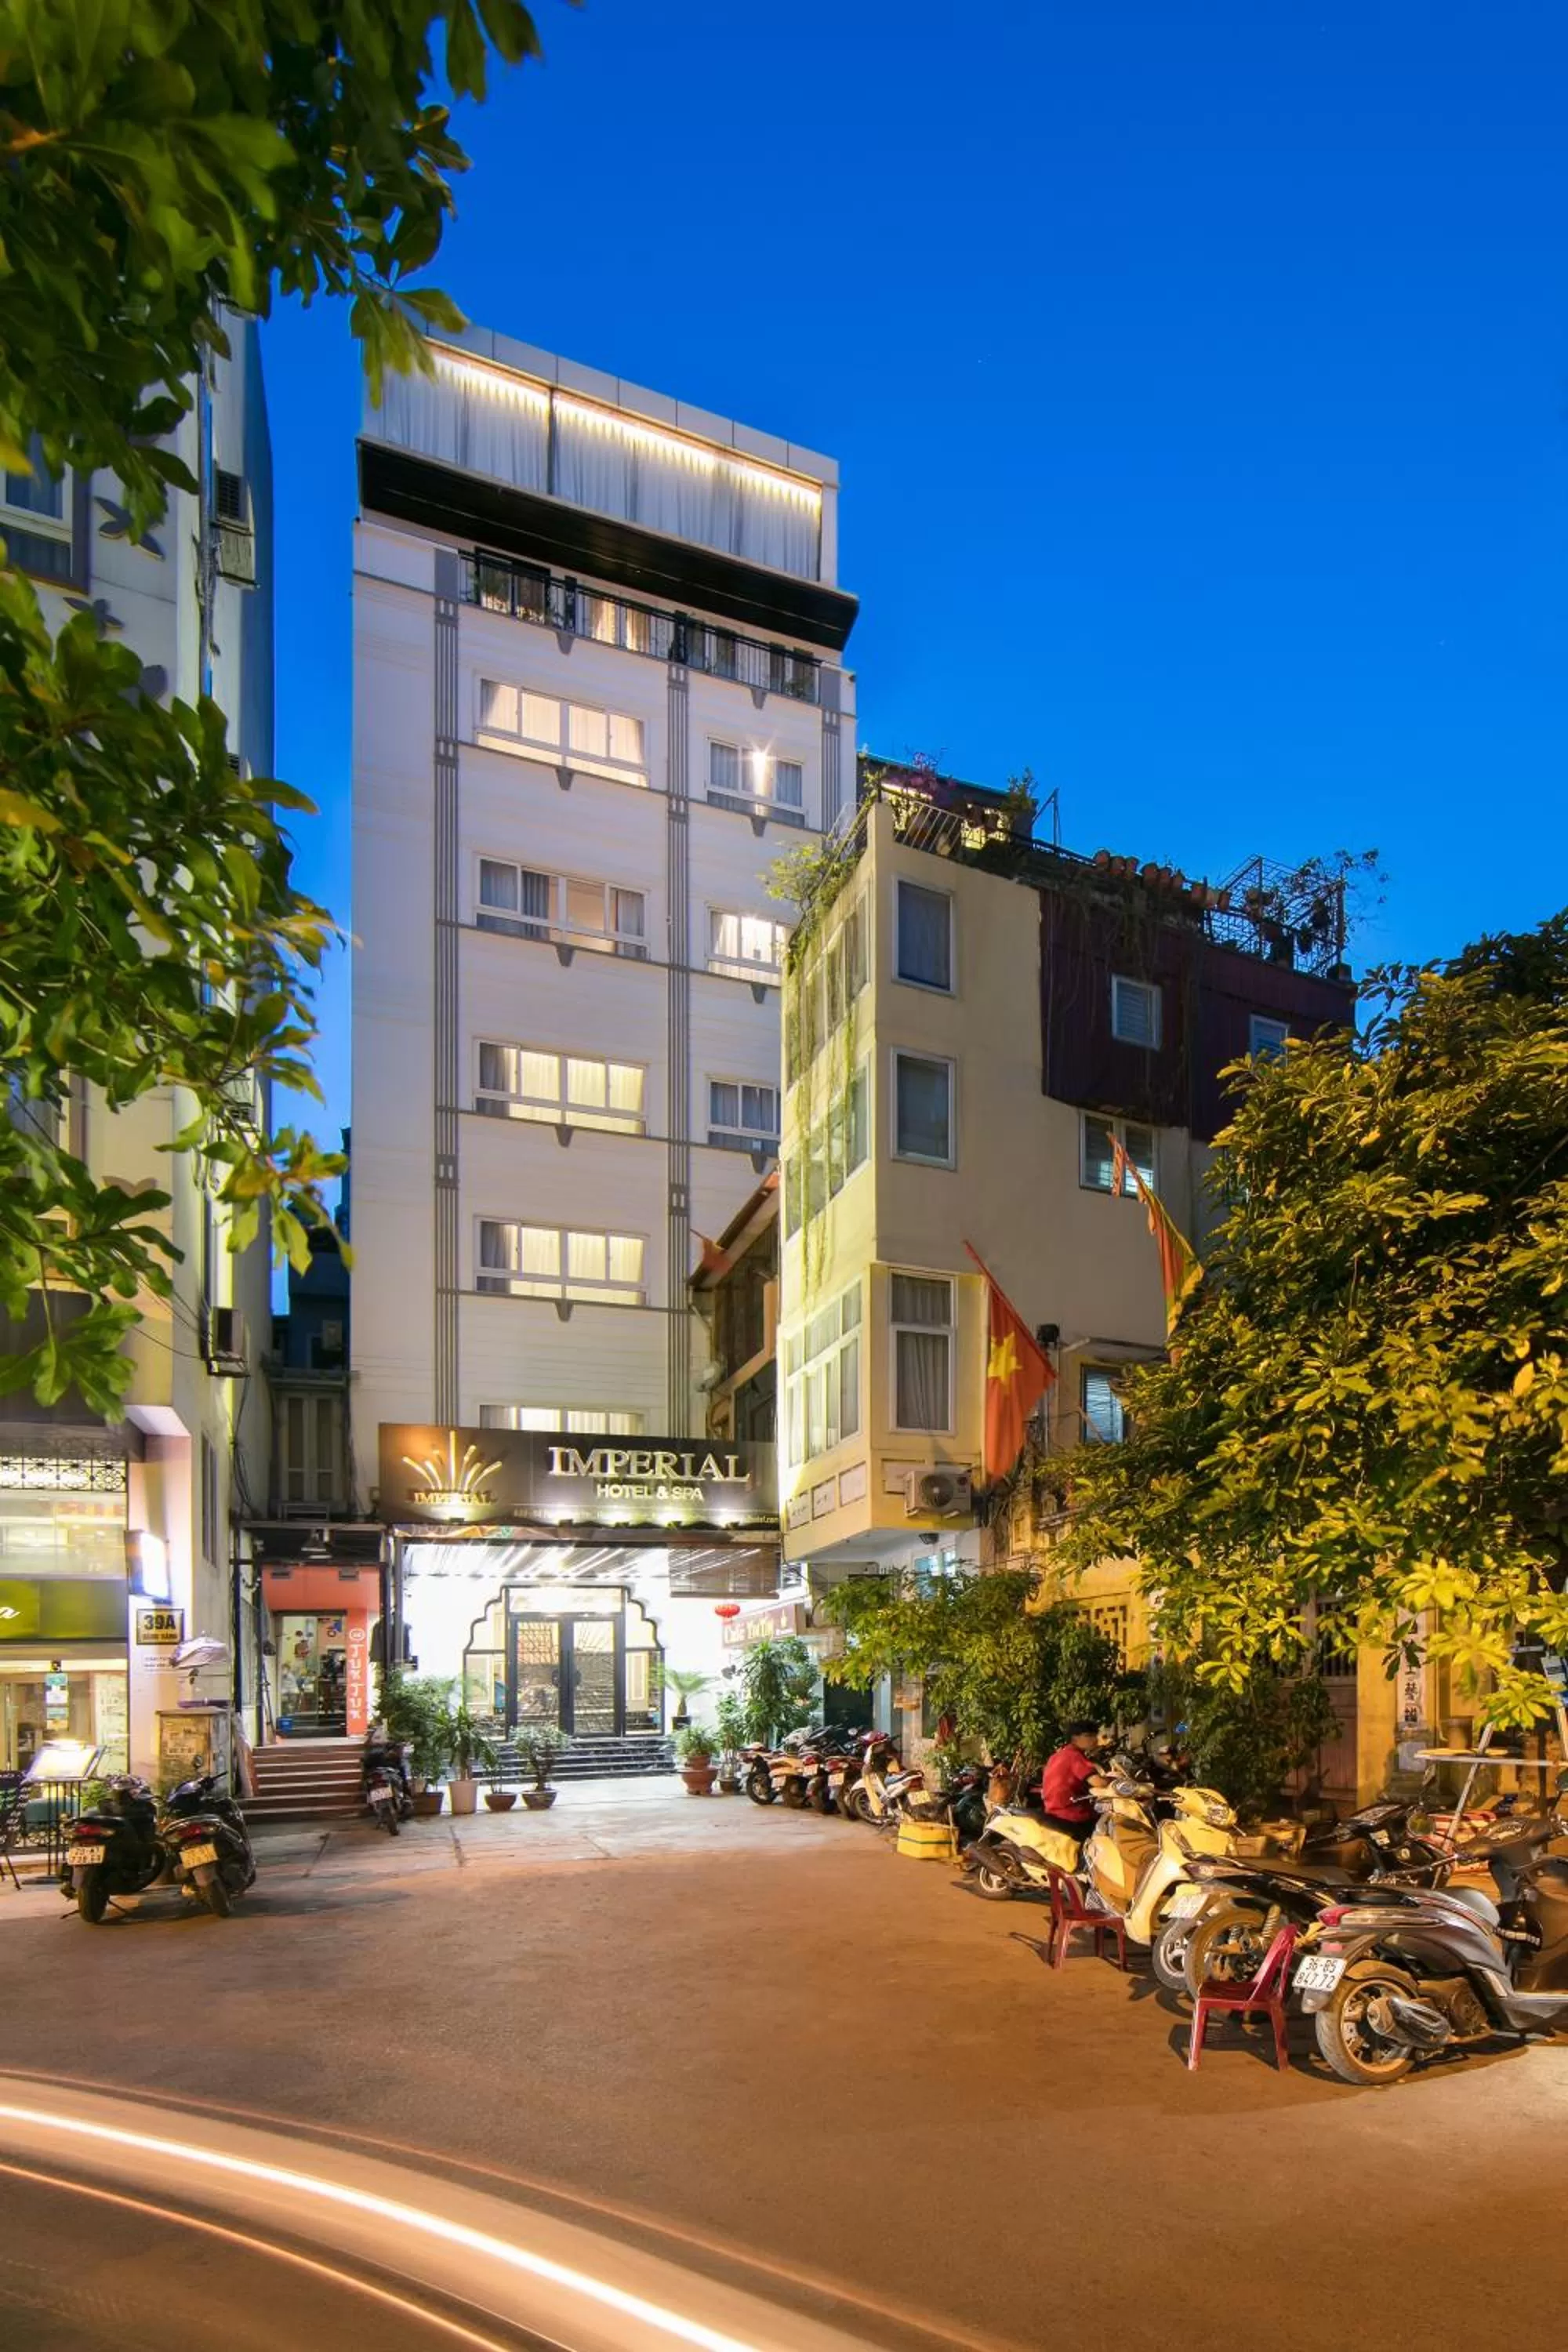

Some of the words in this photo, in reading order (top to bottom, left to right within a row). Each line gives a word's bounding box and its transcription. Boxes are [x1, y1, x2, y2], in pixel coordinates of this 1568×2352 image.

[548, 1446, 750, 1483] IMPERIAL
[597, 1484, 652, 1500] HOTEL
[656, 1486, 667, 1500] &
[671, 1486, 704, 1501] SPA
[143, 1614, 176, 1630] 39A
